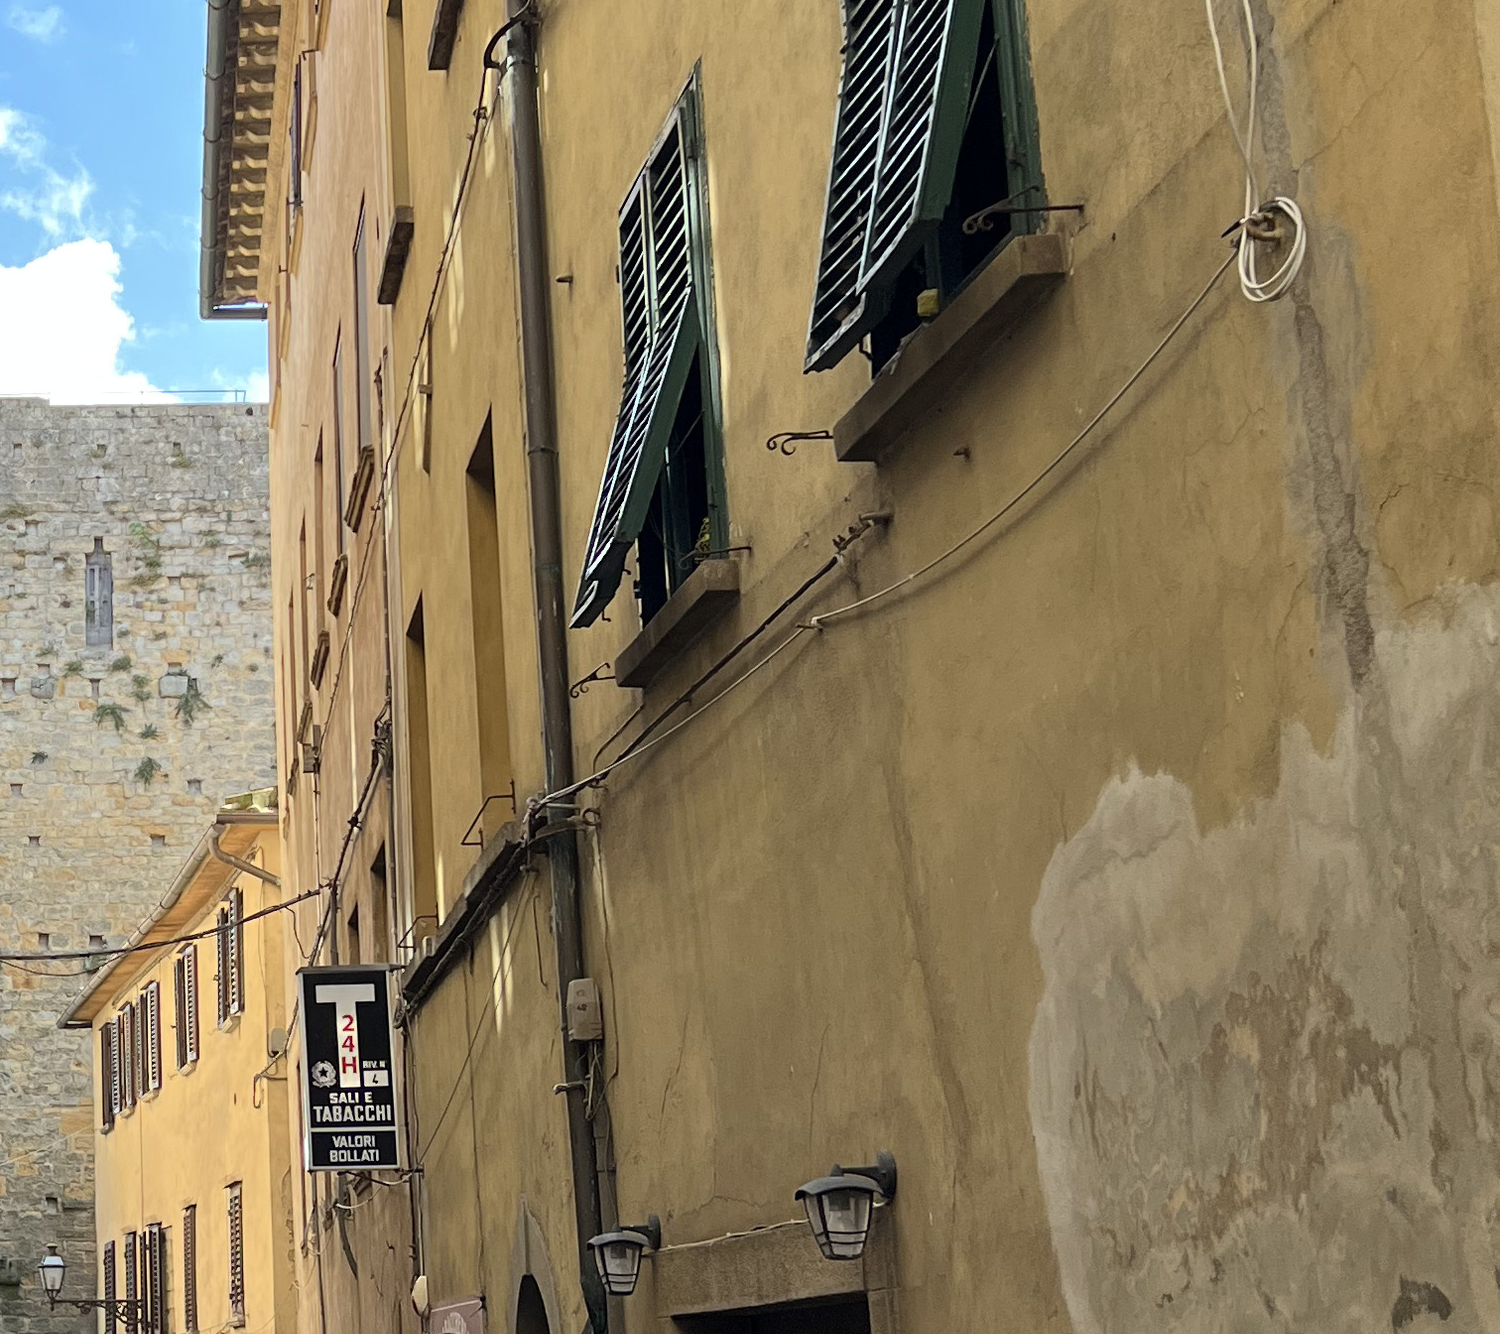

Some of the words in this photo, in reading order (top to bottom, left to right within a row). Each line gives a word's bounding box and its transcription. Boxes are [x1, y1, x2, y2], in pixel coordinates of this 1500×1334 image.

[315, 983, 376, 1088] T
[329, 1092, 359, 1104] SALI
[364, 1091, 373, 1103] E
[312, 1104, 392, 1123] TABACCHI
[332, 1135, 376, 1148] VALORI
[329, 1149, 380, 1163] BOLLATI
